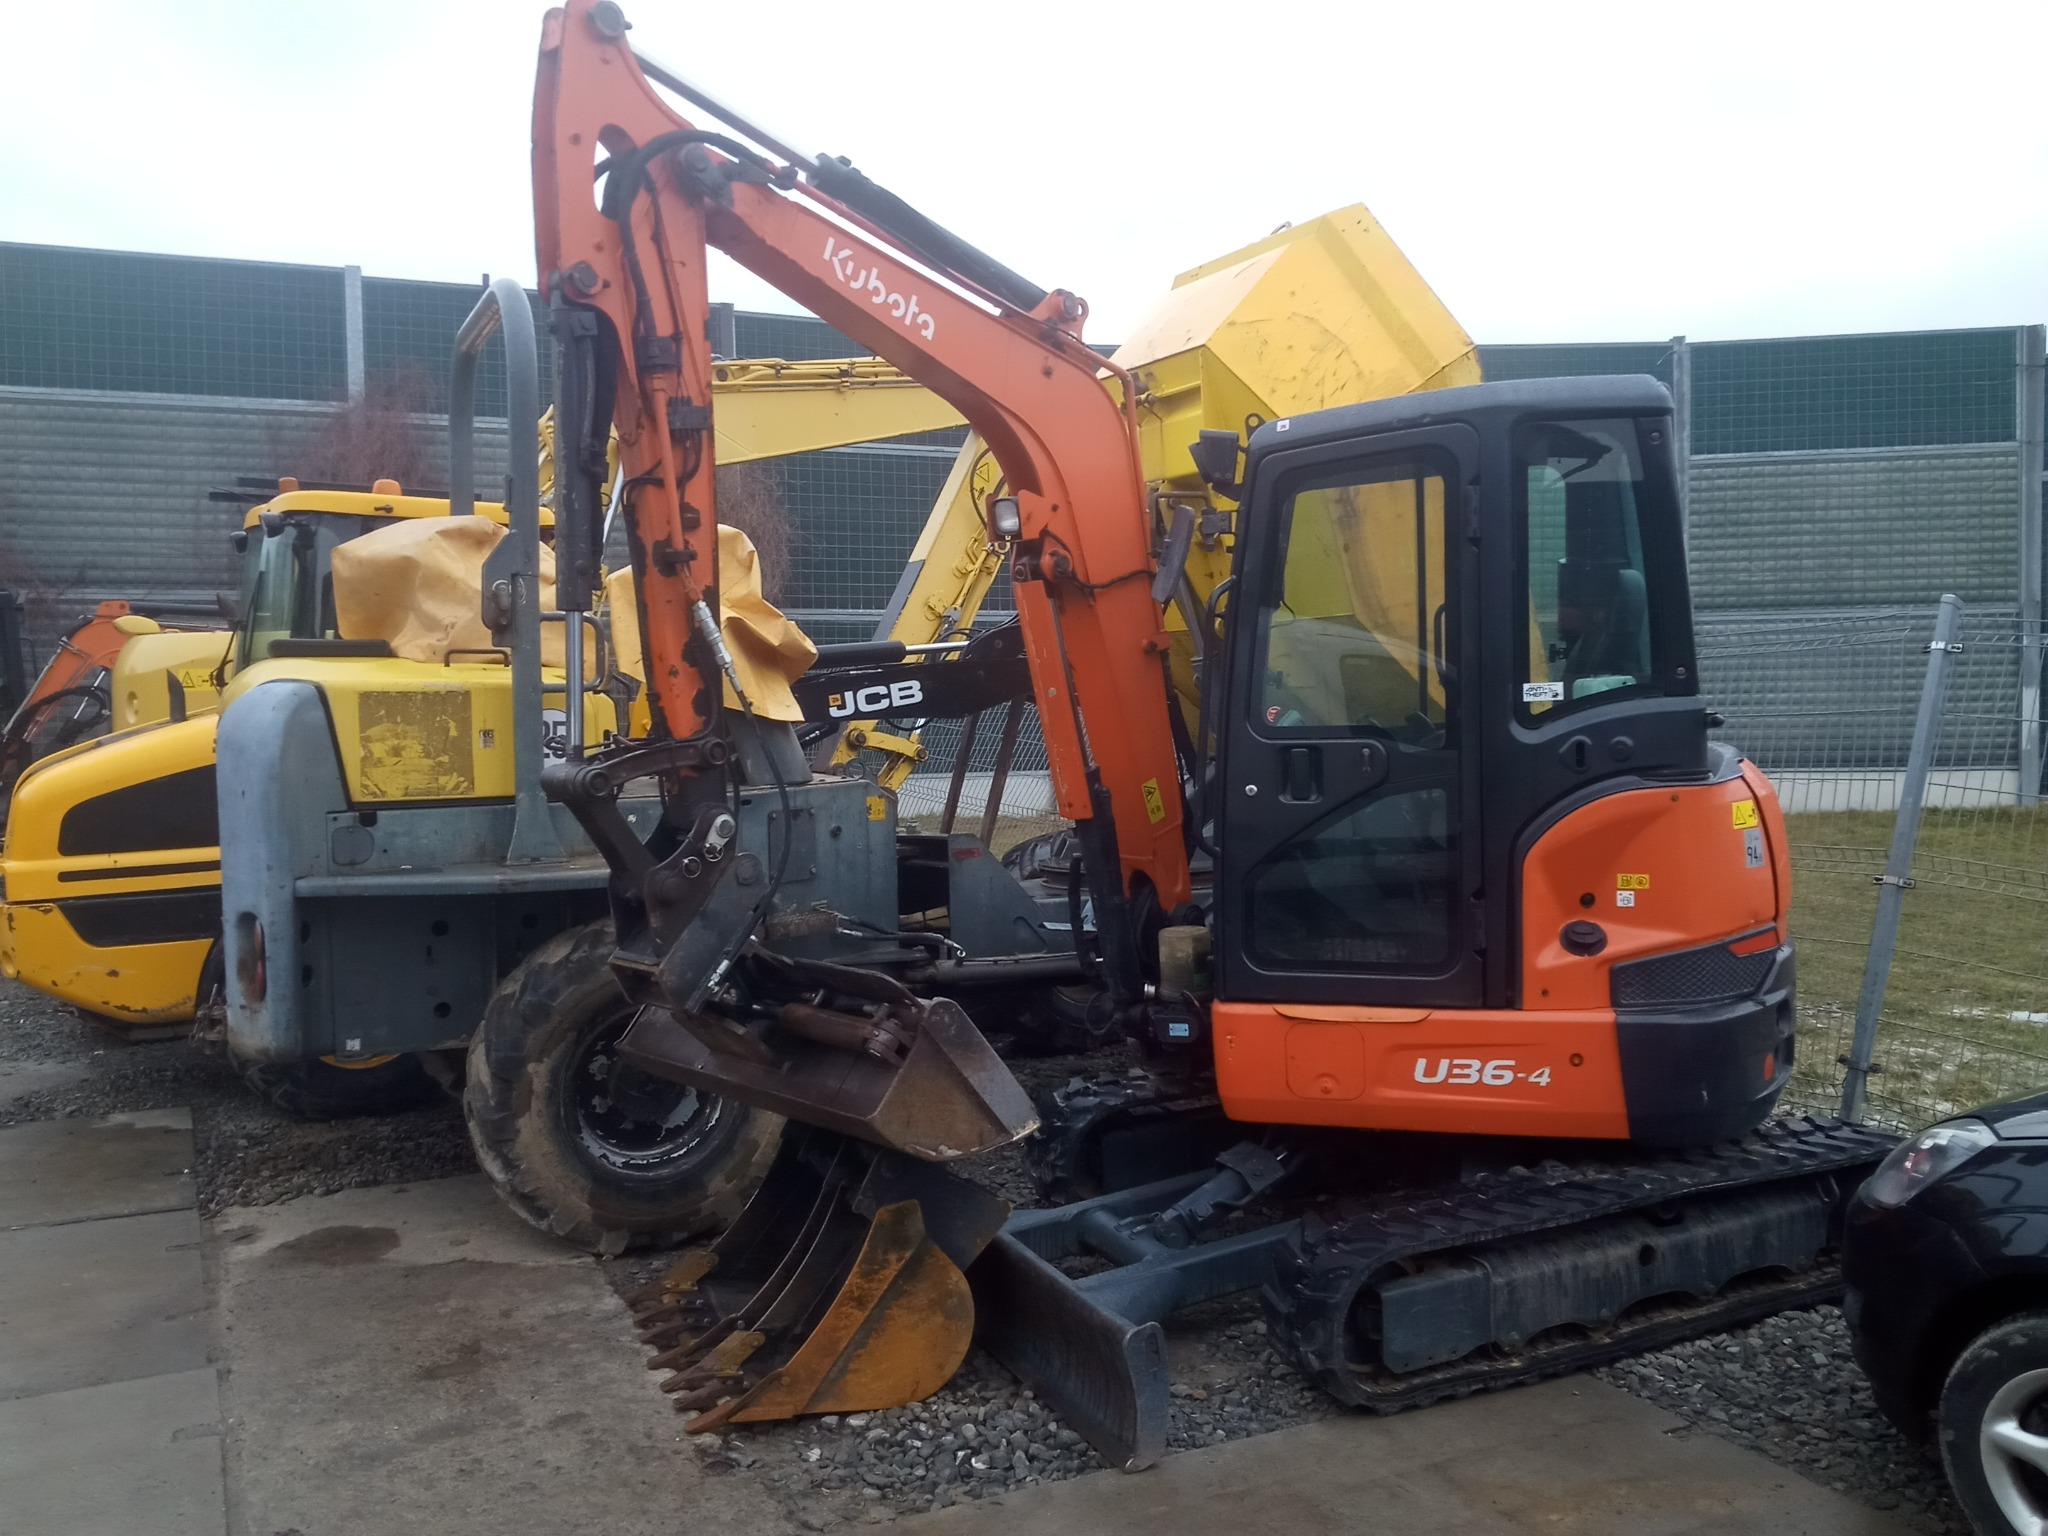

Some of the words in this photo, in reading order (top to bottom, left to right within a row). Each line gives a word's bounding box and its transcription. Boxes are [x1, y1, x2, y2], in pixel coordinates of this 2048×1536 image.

[822, 236, 936, 342] Kubota
[828, 679, 924, 718] JCB
[1747, 845, 1758, 864] 94
[1413, 1057, 1552, 1087] U36-4
